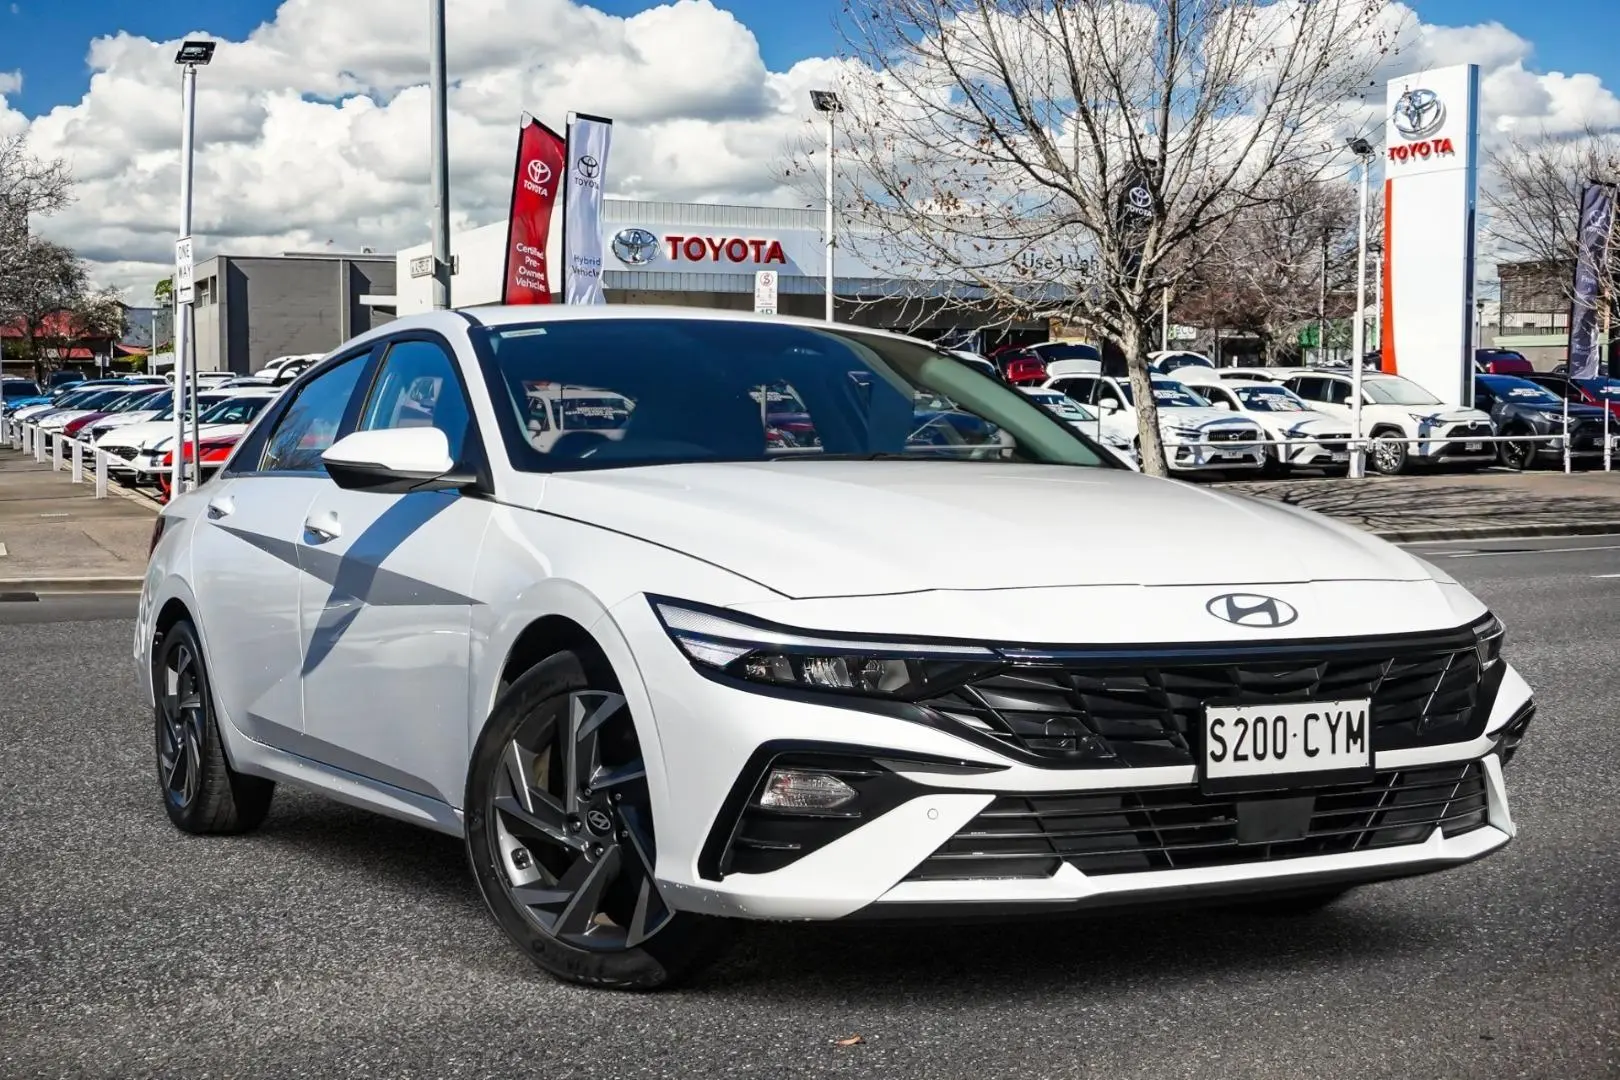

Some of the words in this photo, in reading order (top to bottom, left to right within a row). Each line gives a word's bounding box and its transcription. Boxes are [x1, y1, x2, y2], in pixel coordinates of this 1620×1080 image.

[1388, 138, 1455, 161] TOYOTA
[523, 180, 549, 197] TOYOTA
[1124, 202, 1152, 217] TOYOTA
[178, 244, 191, 260] ONE
[516, 242, 545, 260] Certified
[665, 236, 787, 264] TOYOTA
[525, 256, 541, 267] Pre-
[574, 254, 601, 266] Hybrid
[178, 264, 191, 279] WAY
[518, 265, 545, 281] Owned
[515, 277, 547, 293] Vehicles
